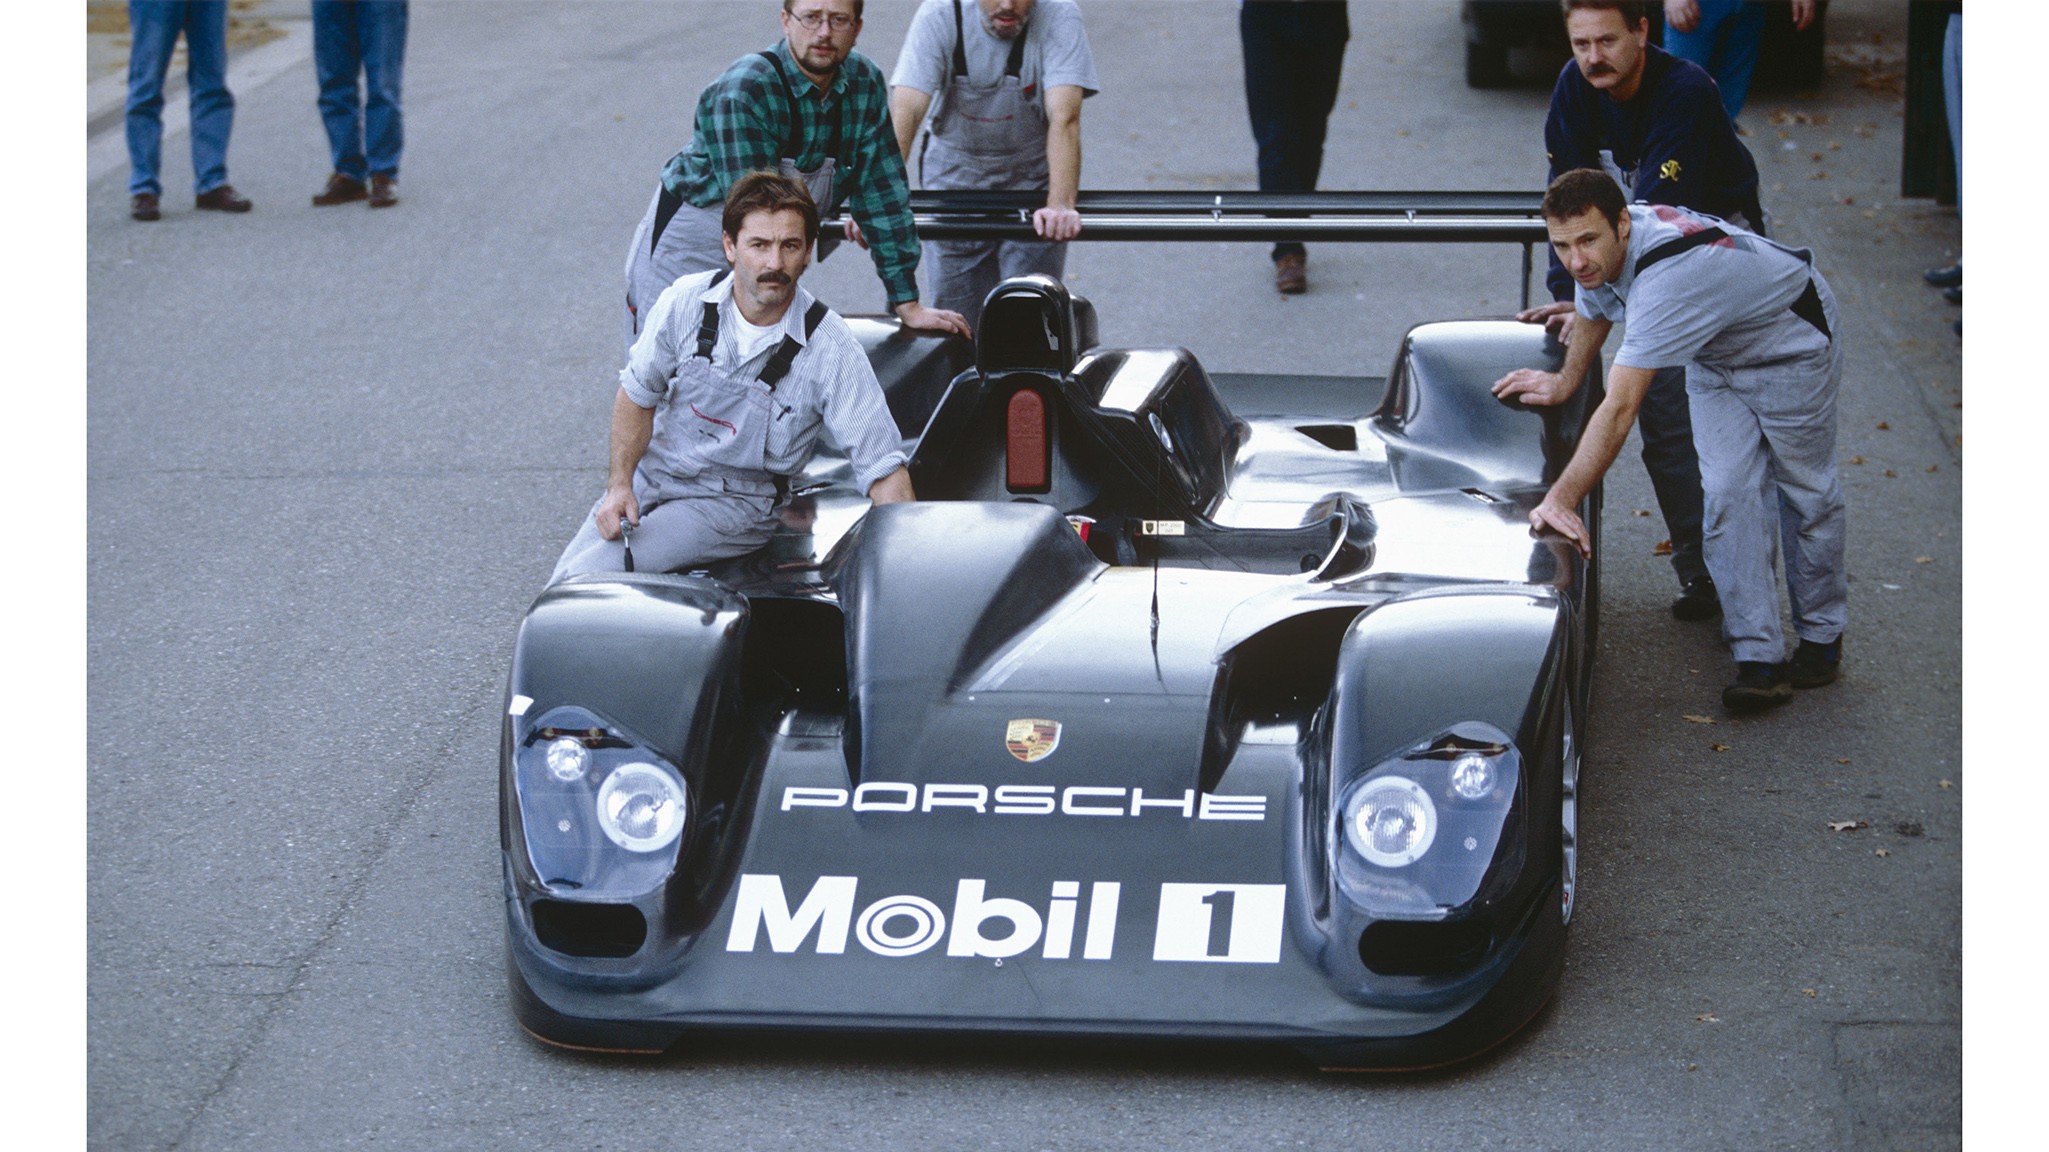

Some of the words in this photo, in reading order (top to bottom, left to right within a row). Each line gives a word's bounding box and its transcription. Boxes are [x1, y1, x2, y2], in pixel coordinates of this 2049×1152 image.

[781, 782, 1267, 820] PORSCHE
[726, 874, 1121, 959] Mobil
[1202, 890, 1235, 956] 1
